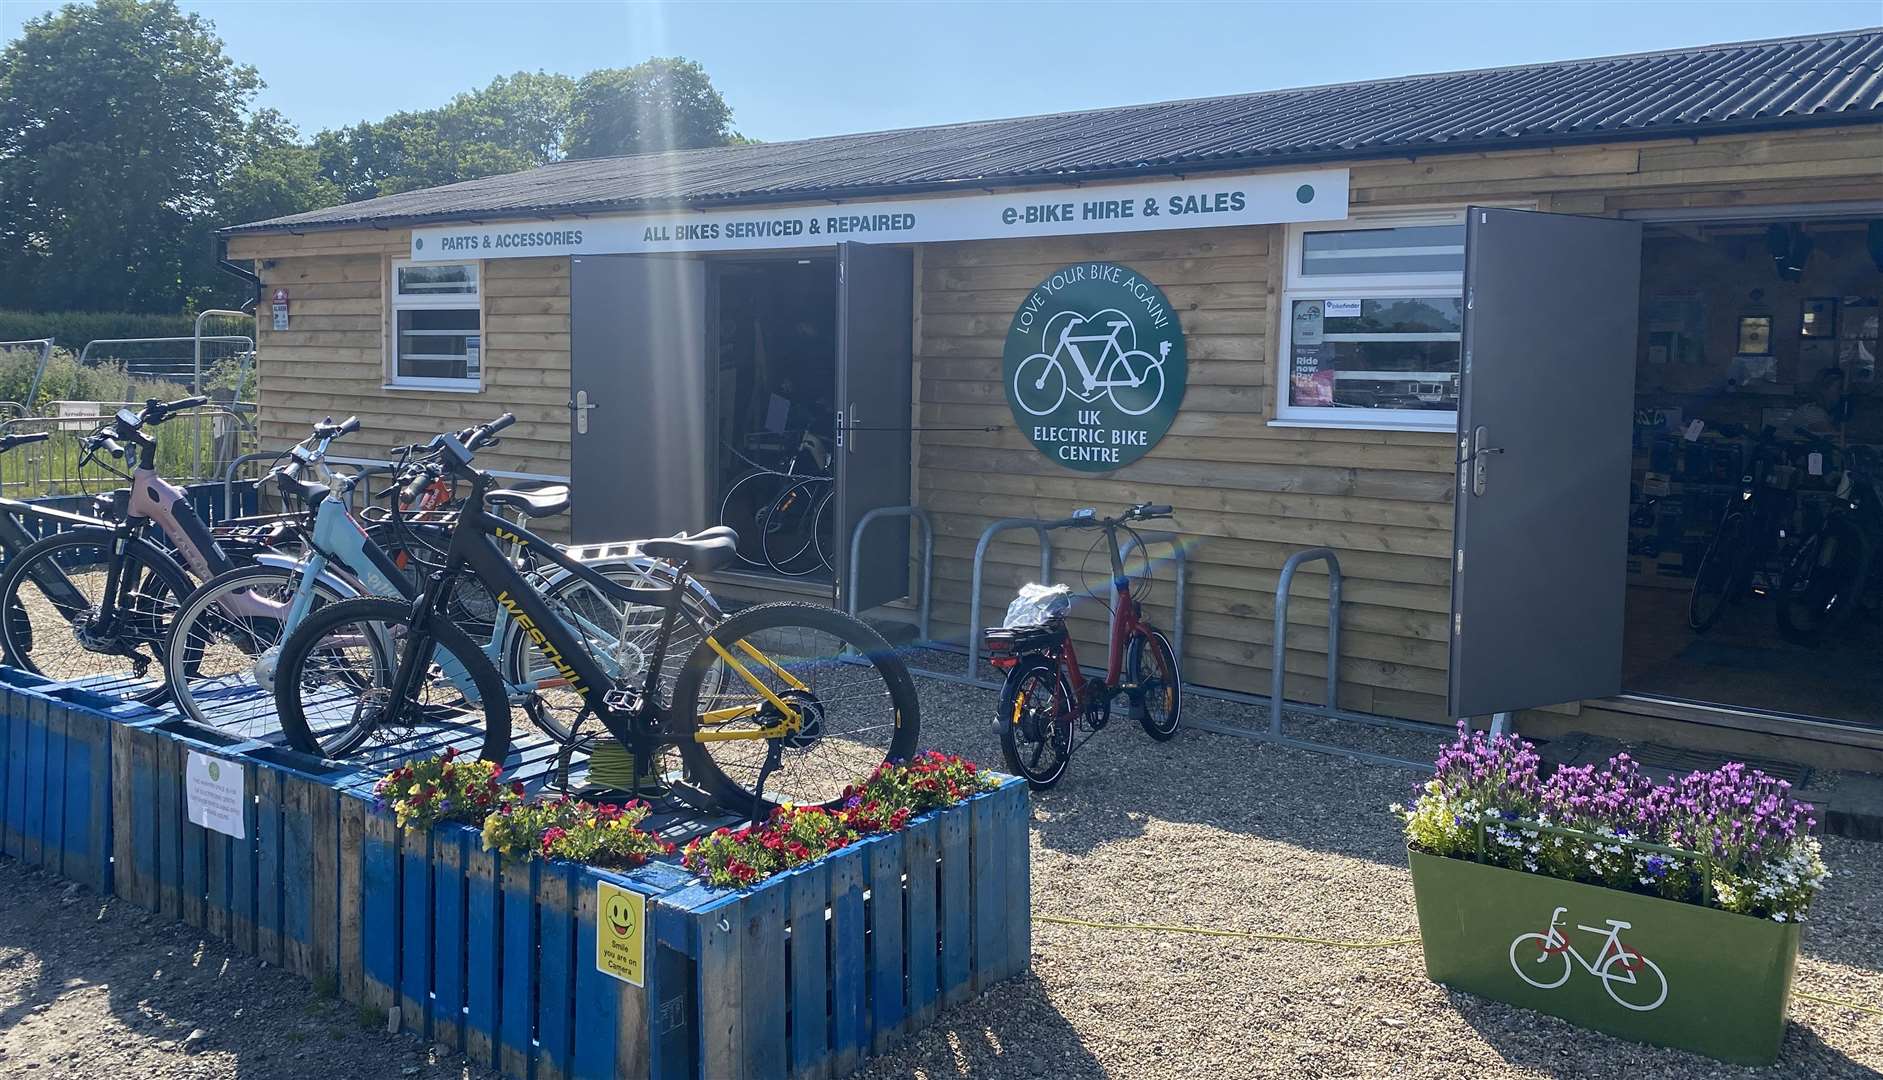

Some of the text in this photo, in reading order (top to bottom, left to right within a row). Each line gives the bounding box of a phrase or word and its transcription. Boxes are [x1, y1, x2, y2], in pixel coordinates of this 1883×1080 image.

[1002, 191, 1246, 225] e-BIKE HIRE & SALES
[643, 213, 916, 241] ALL BIKES SERVICED & REPAIRED
[441, 230, 583, 250] PARTS & ACCESSORIES
[1016, 264, 1169, 335] LOVE YOUR BIKE AGAIN!
[1296, 357, 1318, 365] Ride
[1078, 410, 1102, 425] UK
[1033, 426, 1148, 446] ELECTRIC BIKE
[1058, 445, 1120, 463] CENTRE
[496, 591, 591, 699] WESTHILL
[612, 940, 628, 953] Smile
[603, 949, 637, 967] you are on
[608, 960, 632, 975] Camera
